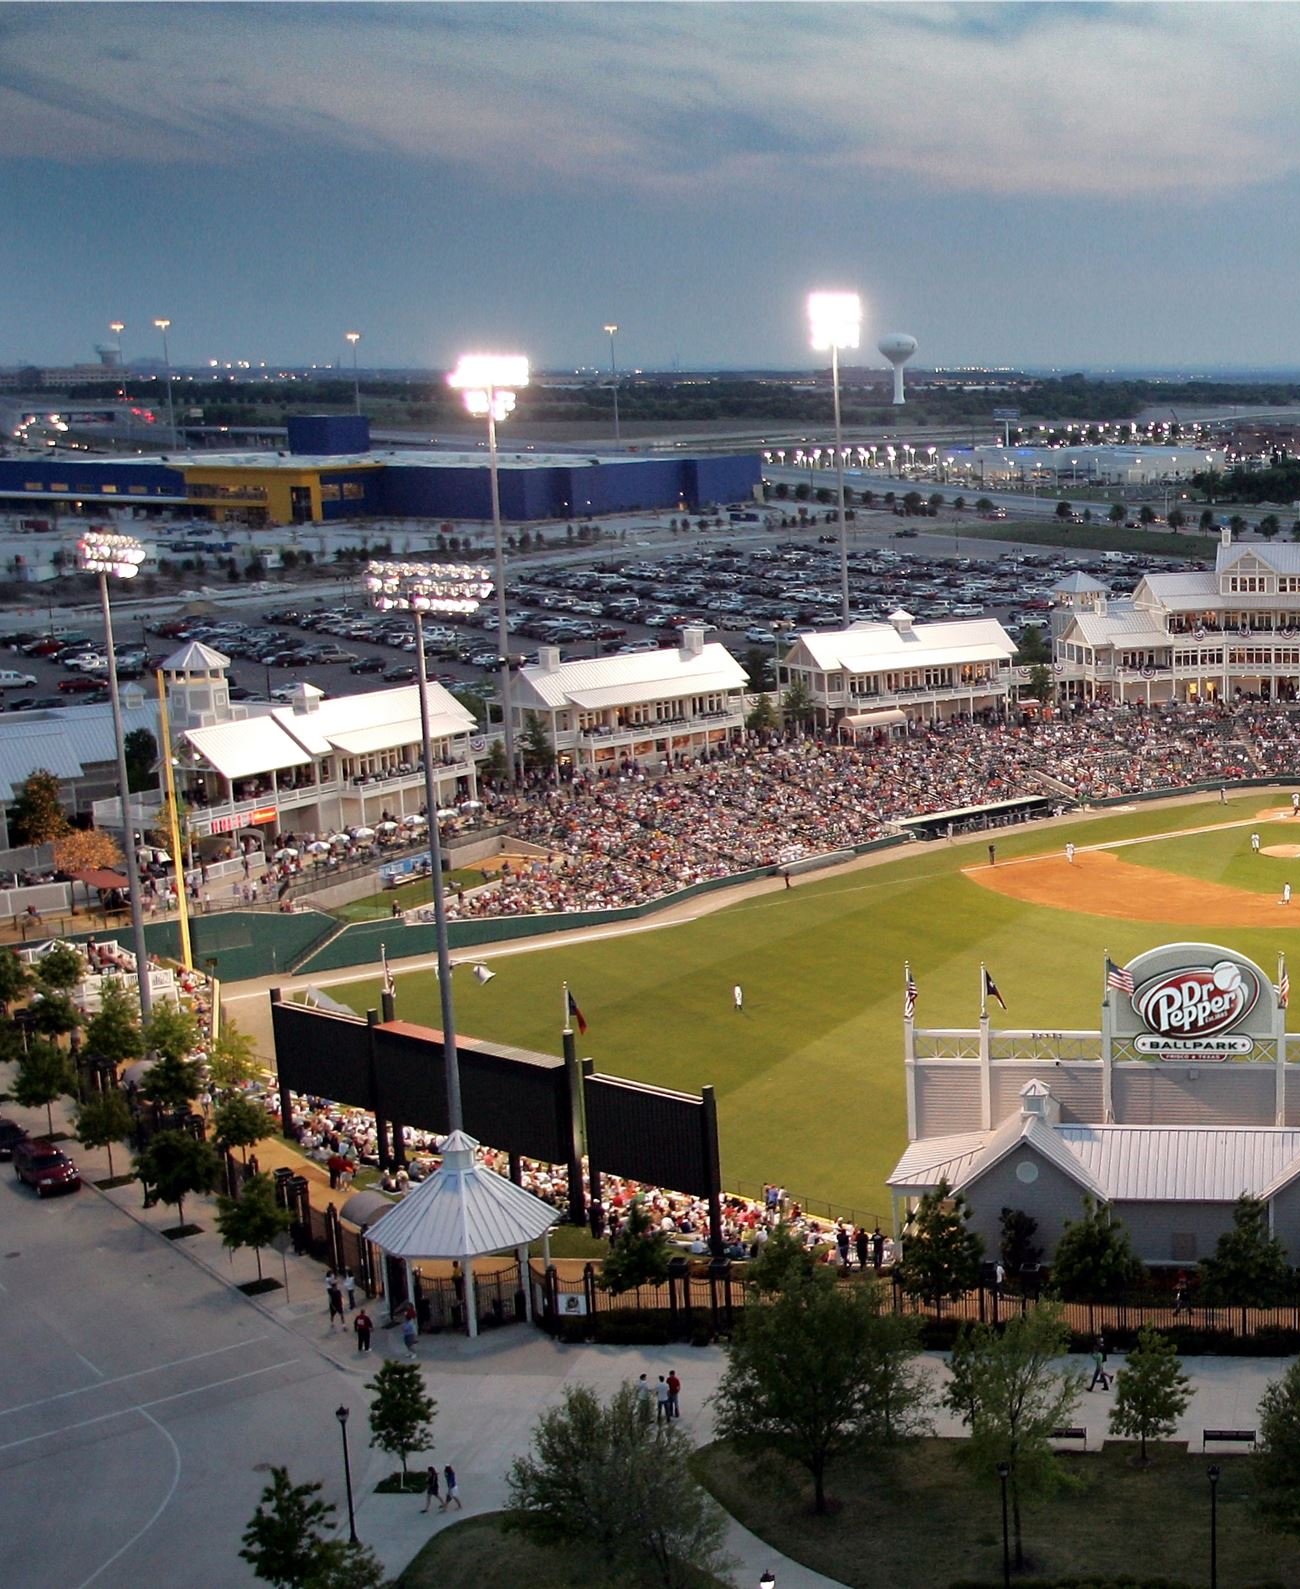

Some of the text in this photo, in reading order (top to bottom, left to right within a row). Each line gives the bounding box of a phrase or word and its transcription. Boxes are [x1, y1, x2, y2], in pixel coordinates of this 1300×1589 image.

[1148, 986, 1236, 1031] Pepper
[1180, 981, 1215, 1009] Dr
[1149, 1041, 1238, 1050] BALLPARK
